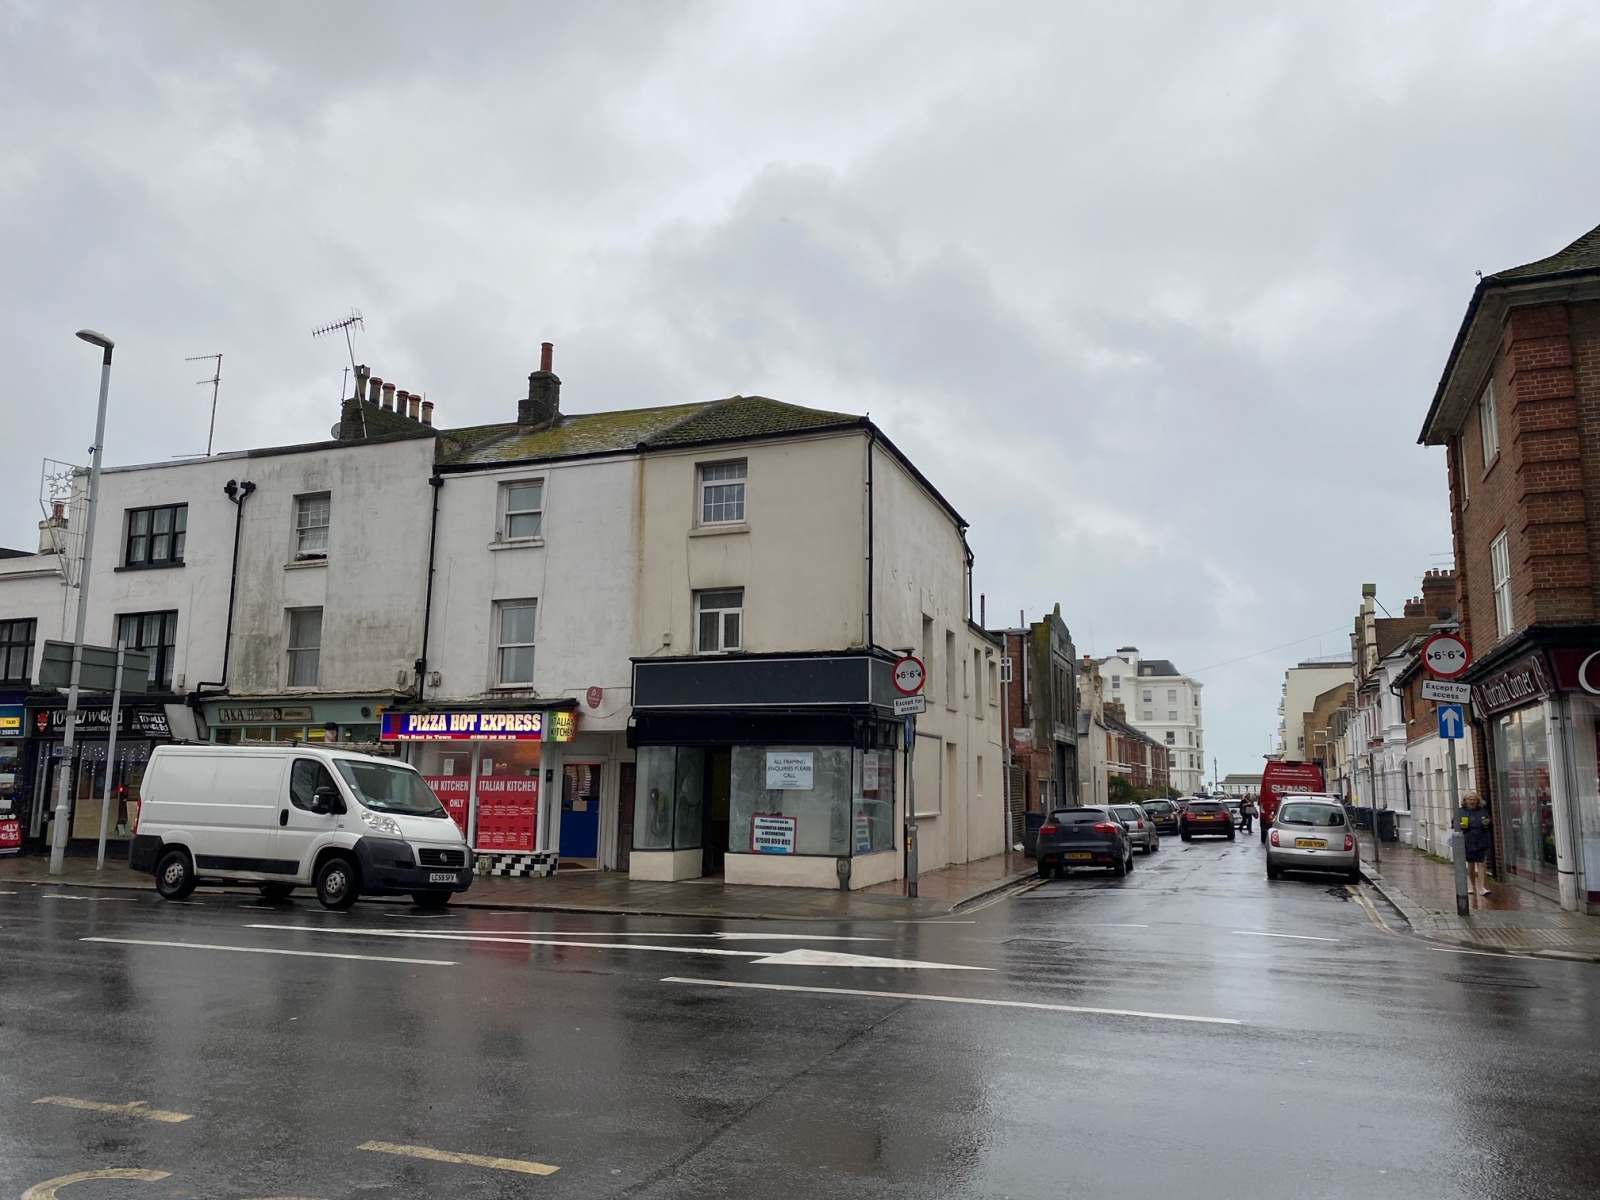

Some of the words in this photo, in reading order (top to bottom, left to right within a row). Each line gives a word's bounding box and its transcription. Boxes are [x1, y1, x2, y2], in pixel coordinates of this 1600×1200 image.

[1425, 682, 1453, 691] Except
[1482, 683, 1511, 708] Curtain
[1503, 671, 1535, 699] Corner
[1432, 691, 1460, 699] access
[895, 699, 913, 707] Except
[408, 714, 447, 731] PIZZA
[450, 714, 478, 731] HOT
[480, 714, 541, 731] EXPRESS
[551, 715, 575, 727] ITALIAN
[551, 726, 576, 737] KITCHEN
[440, 780, 469, 791] KITCHEN
[479, 780, 505, 791] ITALIAN
[506, 780, 537, 792] KITCHEN
[449, 798, 464, 807] ONLY
